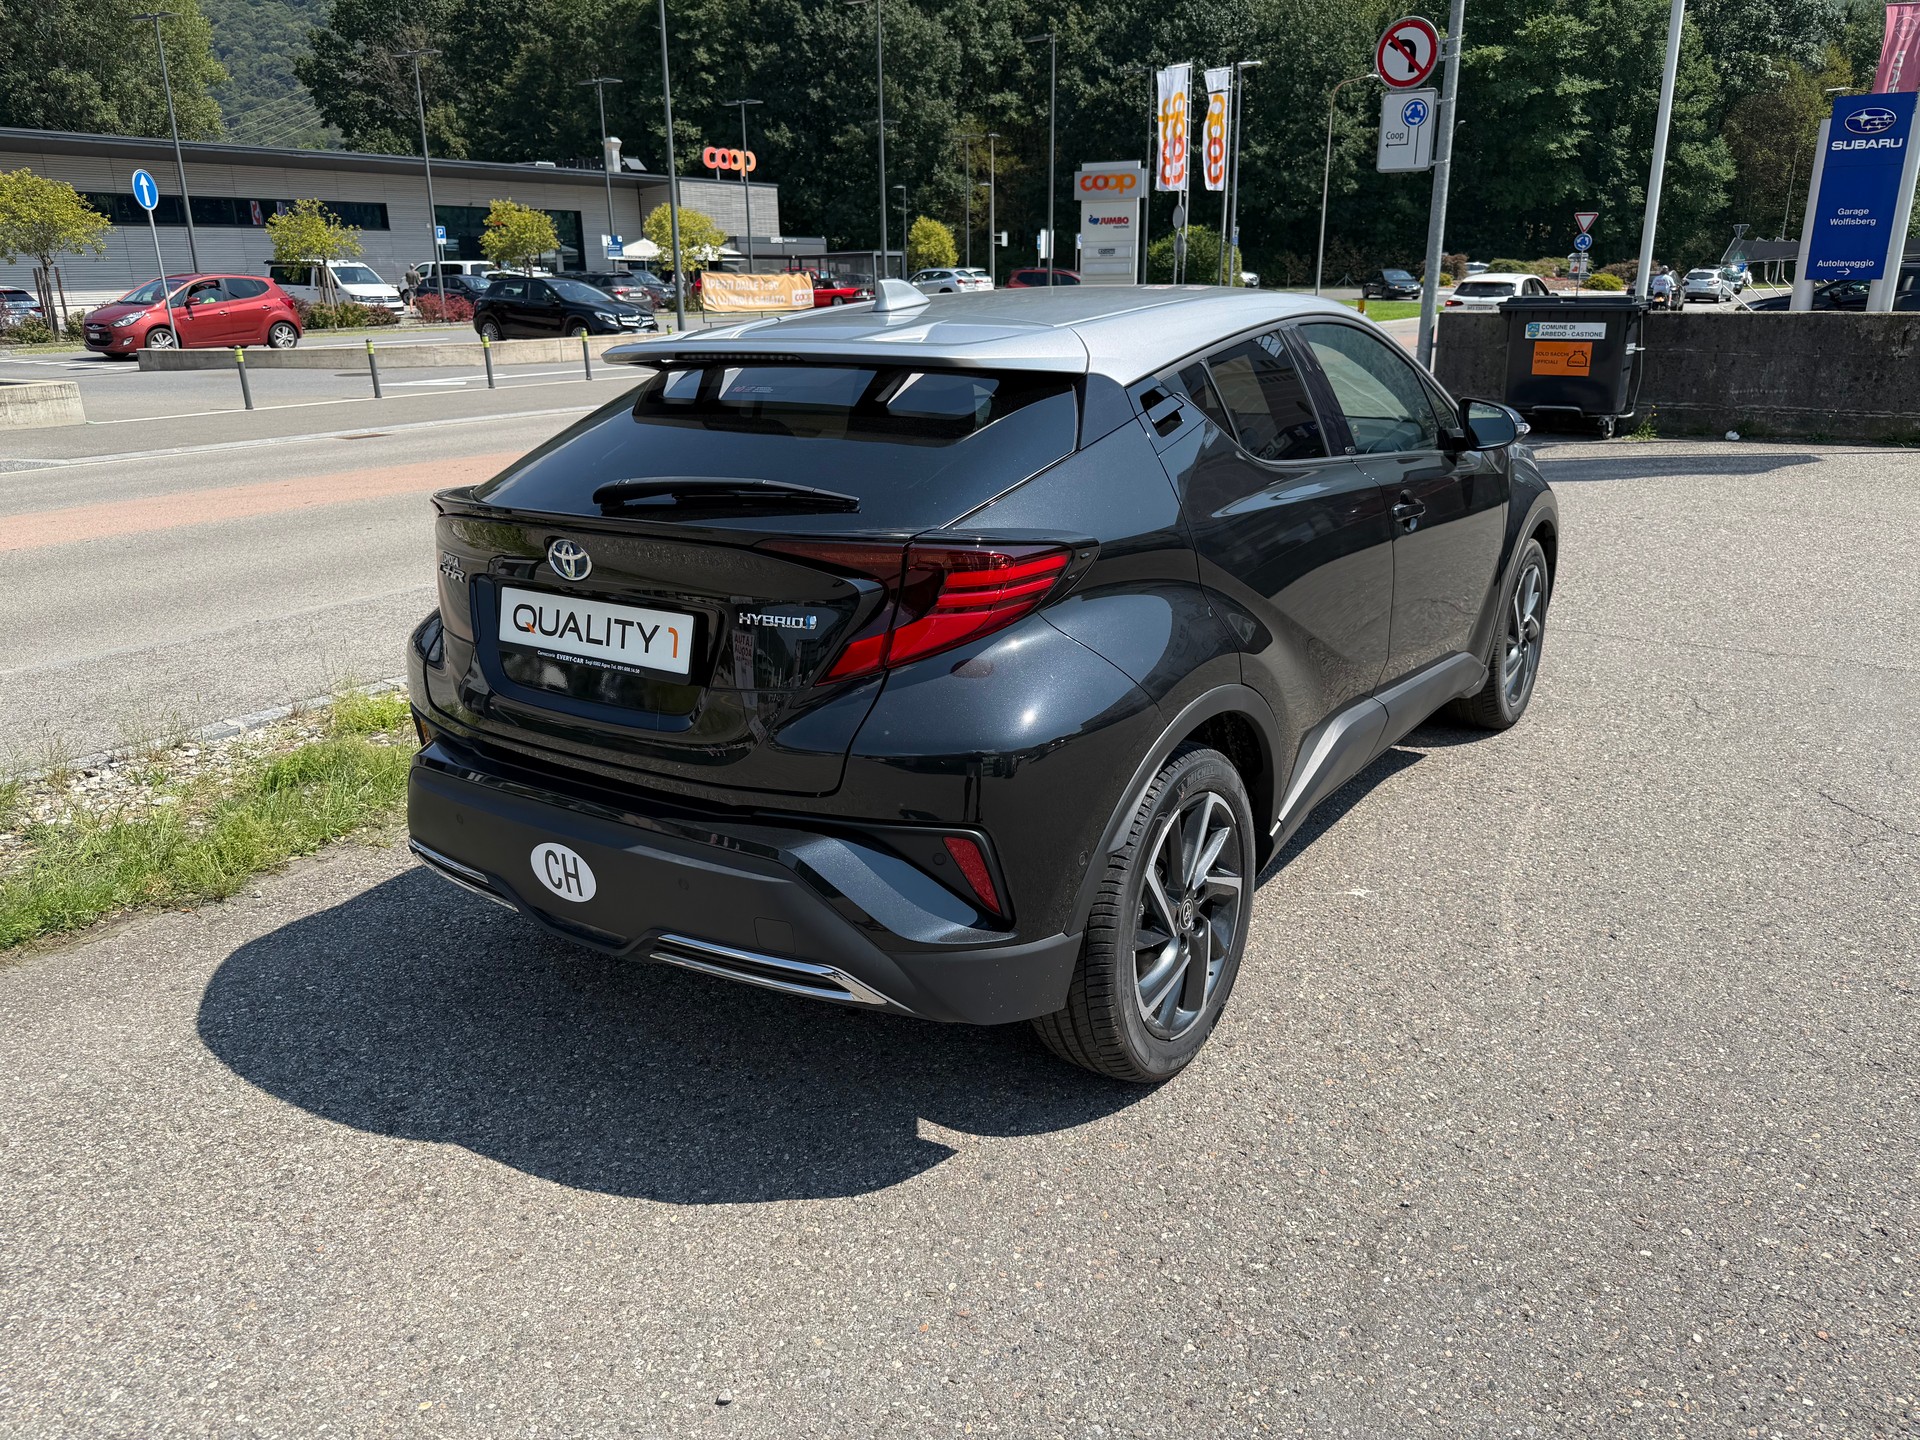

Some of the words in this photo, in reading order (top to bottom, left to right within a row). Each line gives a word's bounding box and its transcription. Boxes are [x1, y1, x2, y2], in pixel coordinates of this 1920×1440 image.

[1158, 92, 1185, 186] coop
[1206, 94, 1225, 184] coop
[1386, 131, 1404, 141] Coop
[1831, 138, 1903, 150] SUBARU
[703, 147, 756, 177] coop
[1080, 174, 1136, 194] coop
[1837, 208, 1869, 216] Garage
[1100, 217, 1129, 225] JUMBO
[1830, 217, 1876, 226] Wolfisberg
[1817, 259, 1874, 268] Autolavaggio
[736, 280, 758, 291] DALLE
[739, 612, 804, 629] HYBRID
[556, 653, 584, 664] EVERY-CAR
[545, 849, 583, 897] CH
